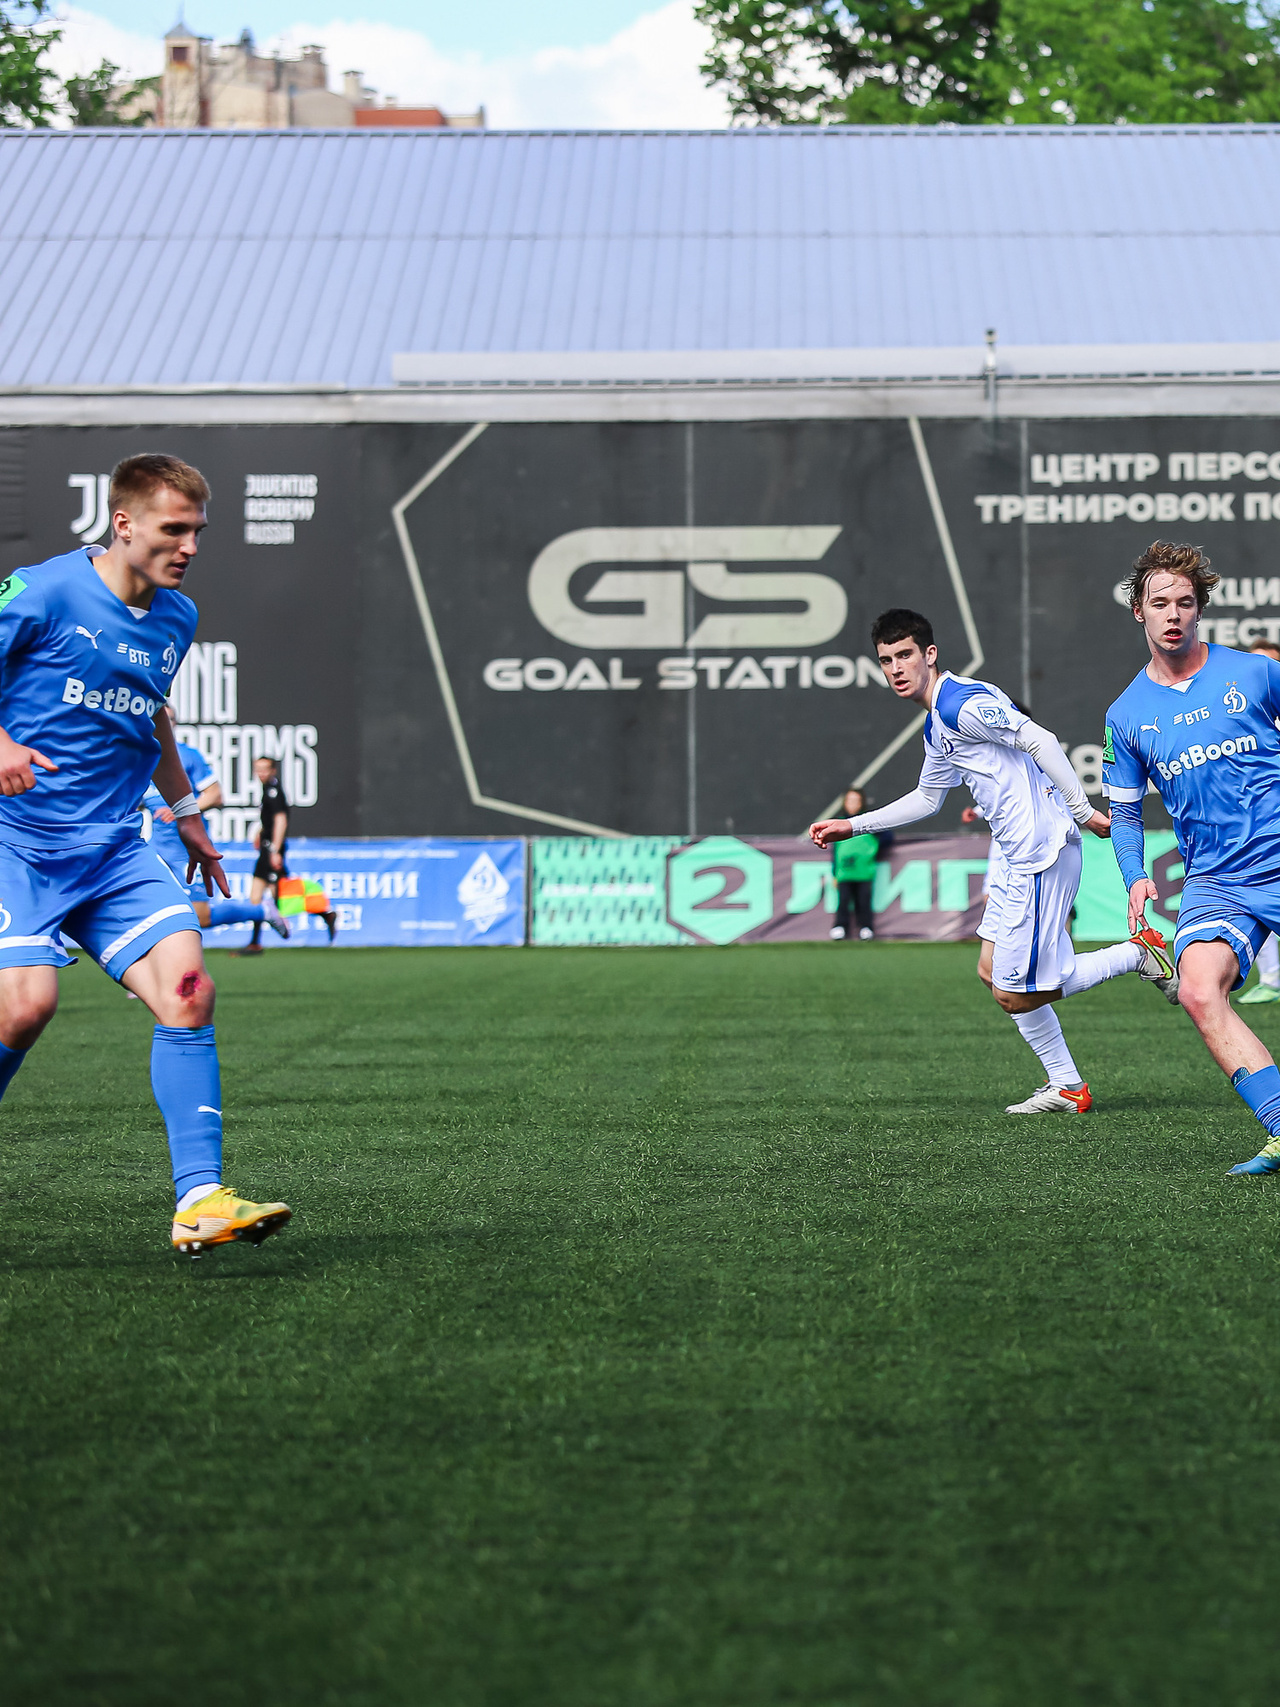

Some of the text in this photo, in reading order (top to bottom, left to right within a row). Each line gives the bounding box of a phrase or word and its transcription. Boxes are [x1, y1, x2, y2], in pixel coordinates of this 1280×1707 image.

[245, 474, 318, 497] JUVENTUS
[1032, 453, 1161, 487] ЦЕНТР
[244, 498, 315, 521] ACADEMY
[975, 493, 1236, 524] ТРЕНИРОВОК
[528, 525, 848, 650] GS
[128, 648, 151, 667] ВТБ
[483, 658, 642, 692] GOAL
[1184, 706, 1211, 726] ВТБ
[1156, 735, 1258, 782] BetBoom
[692, 866, 750, 910] 2
